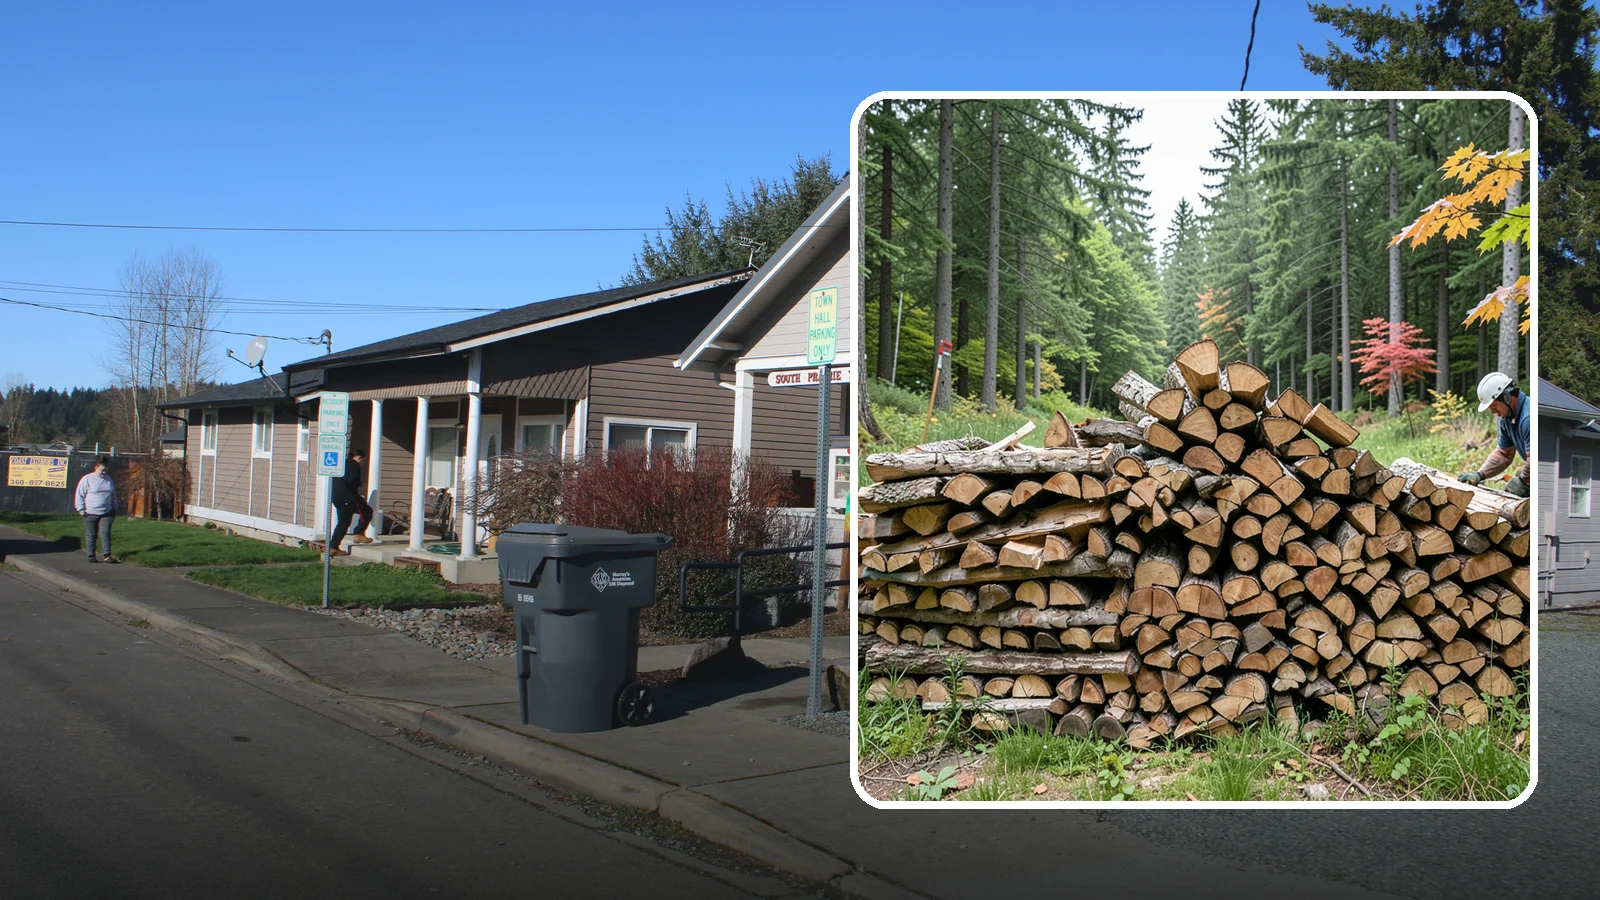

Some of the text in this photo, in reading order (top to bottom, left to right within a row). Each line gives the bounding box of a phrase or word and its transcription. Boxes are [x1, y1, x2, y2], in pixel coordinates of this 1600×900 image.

[815, 294, 833, 308] TOWN
[814, 311, 831, 324] HALL
[810, 326, 836, 341] PARKING
[813, 344, 831, 357] ONLY
[775, 373, 801, 384] SOUTH
[807, 371, 842, 382] PRIE
[323, 409, 345, 417] PARKING
